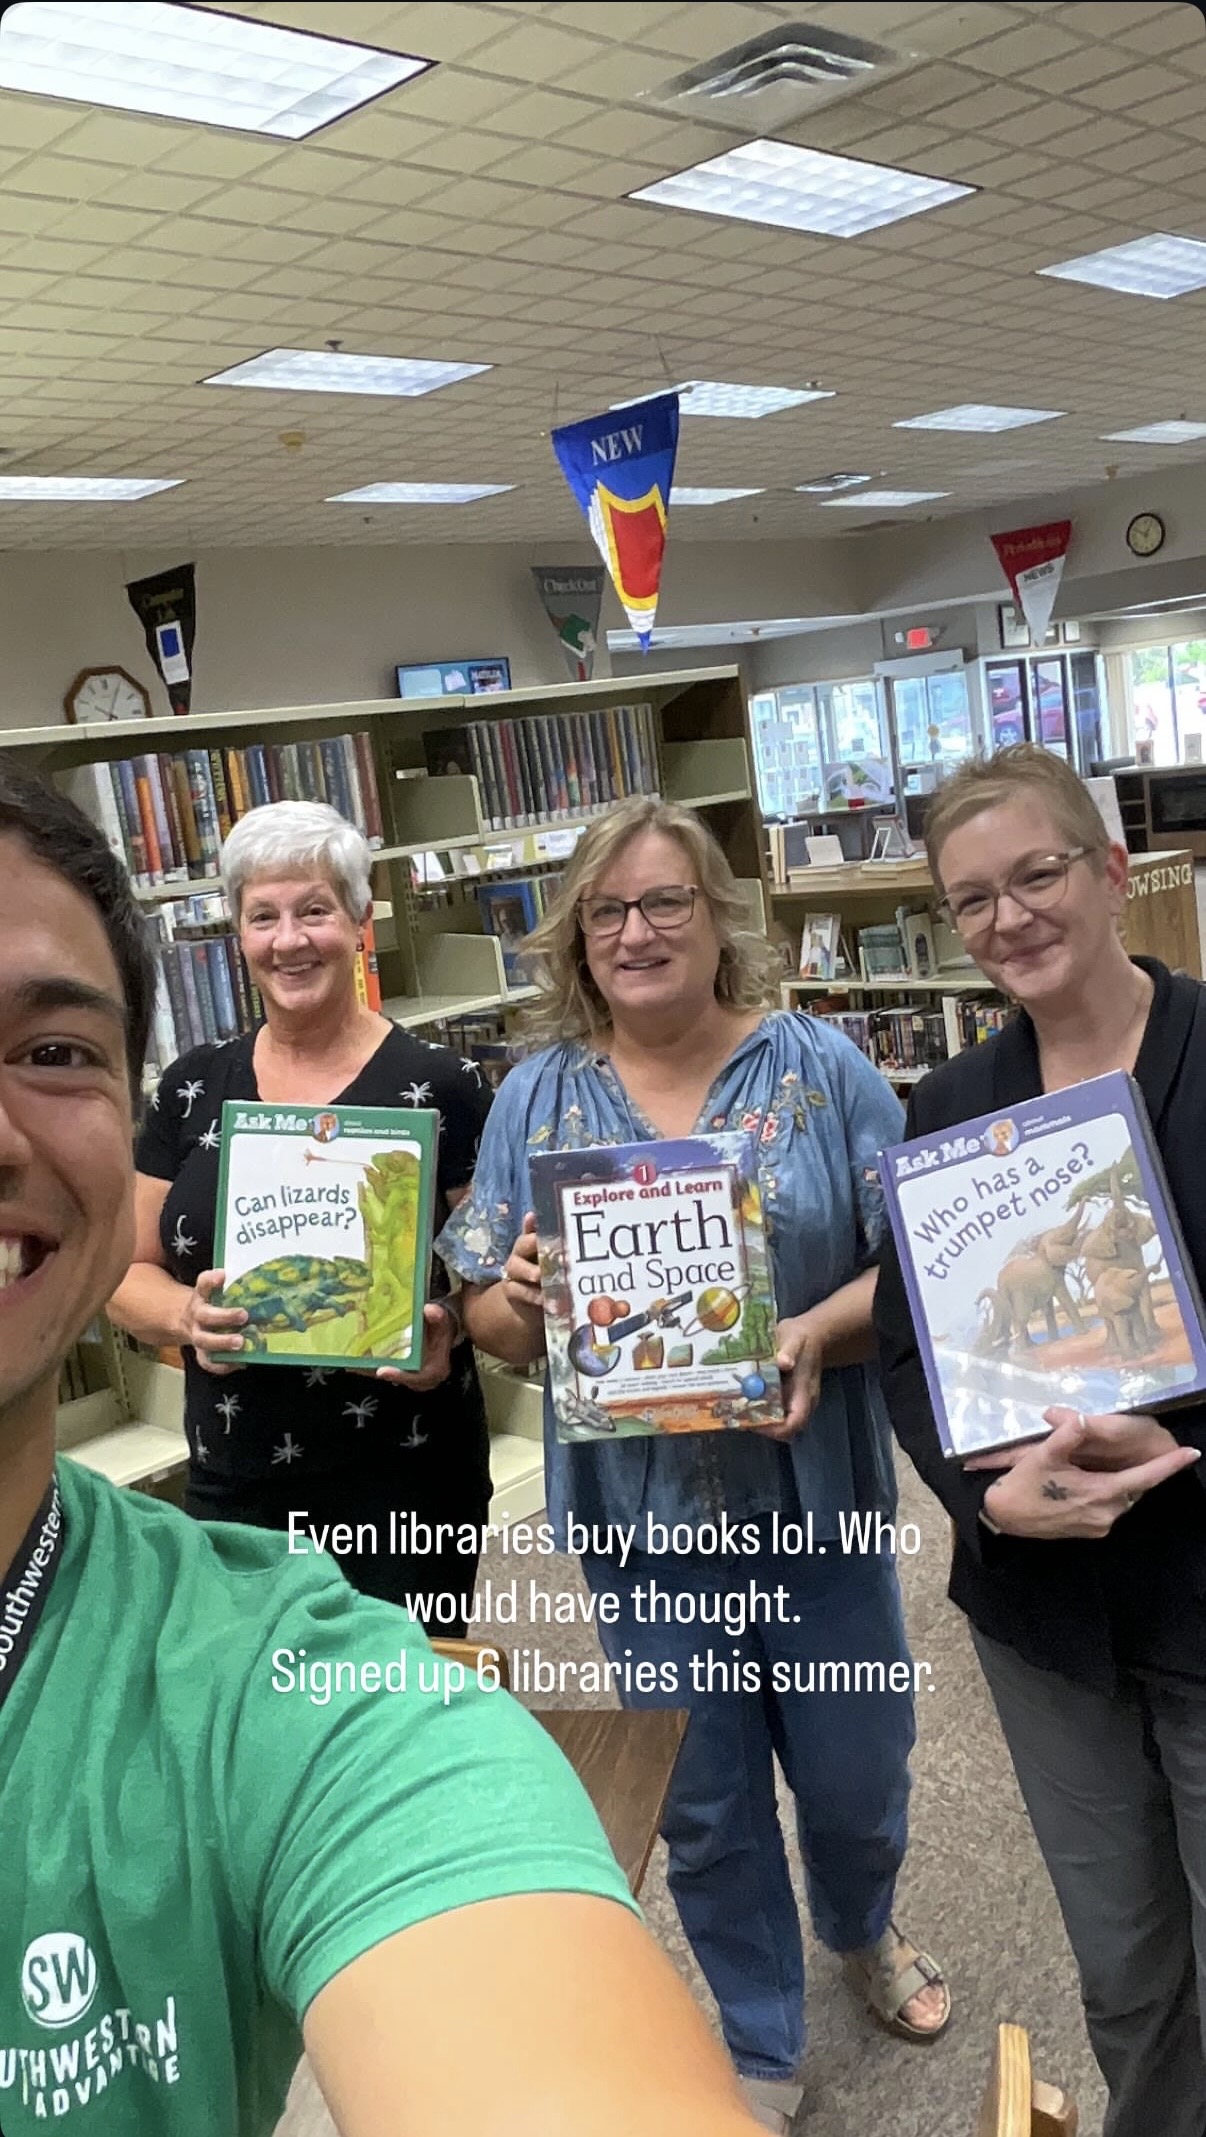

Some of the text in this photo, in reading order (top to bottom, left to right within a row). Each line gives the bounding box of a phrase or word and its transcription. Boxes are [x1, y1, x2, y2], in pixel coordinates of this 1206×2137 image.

[591, 424, 644, 466] NEW
[1024, 563, 1055, 582] NEWS
[233, 1112, 272, 1130] Ask
[640, 1165, 648, 1181] 1
[895, 1149, 940, 1178] Ask
[234, 1184, 351, 1217] Can lizards
[573, 1179, 723, 1208] Explore and Learn
[914, 1156, 1045, 1244] Who has a
[923, 1142, 1095, 1281] trumpet nose?
[236, 1207, 357, 1245] disappear?
[571, 1200, 733, 1264] Earth
[578, 1259, 735, 1296] and Space
[28, 1946, 91, 2012] SW
